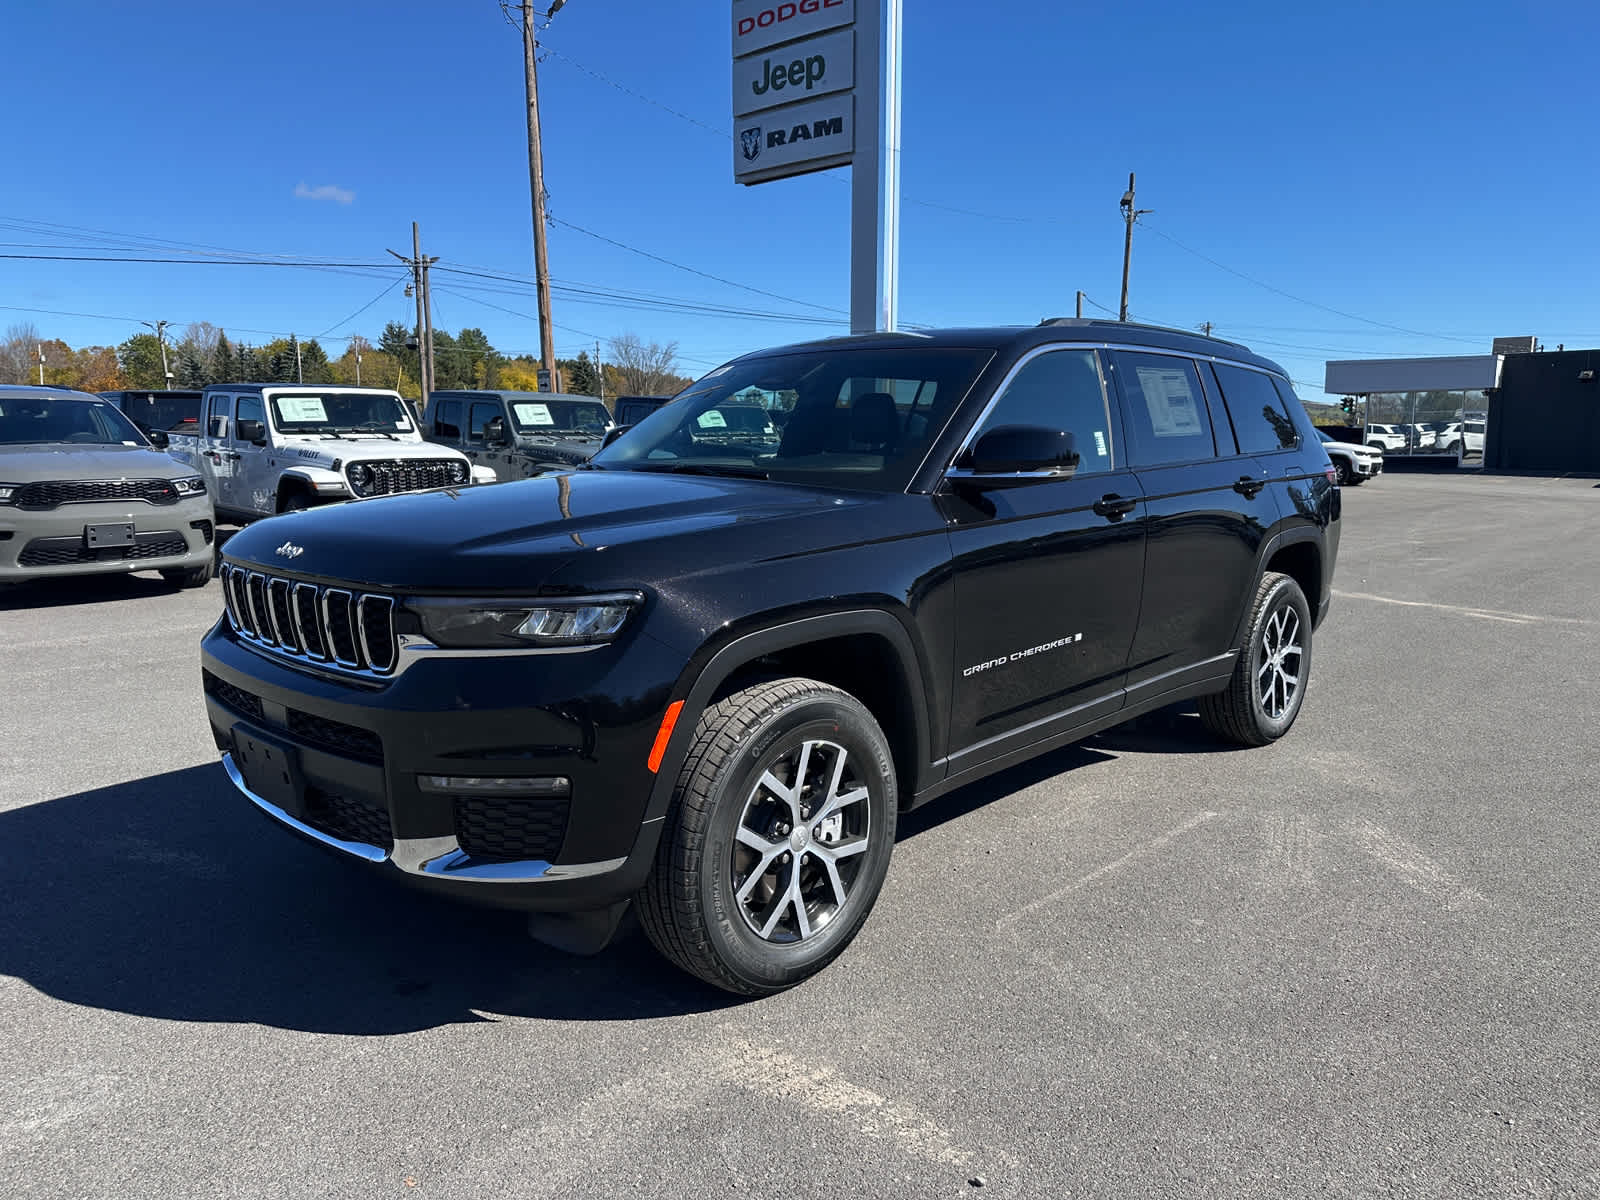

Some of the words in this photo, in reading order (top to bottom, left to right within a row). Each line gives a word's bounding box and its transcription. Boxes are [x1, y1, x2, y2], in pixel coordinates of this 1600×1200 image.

[752, 54, 826, 95] Jeep
[767, 117, 843, 148] RAM
[963, 656, 1007, 677] GRAND
[1010, 636, 1073, 661] CHEROKEE
